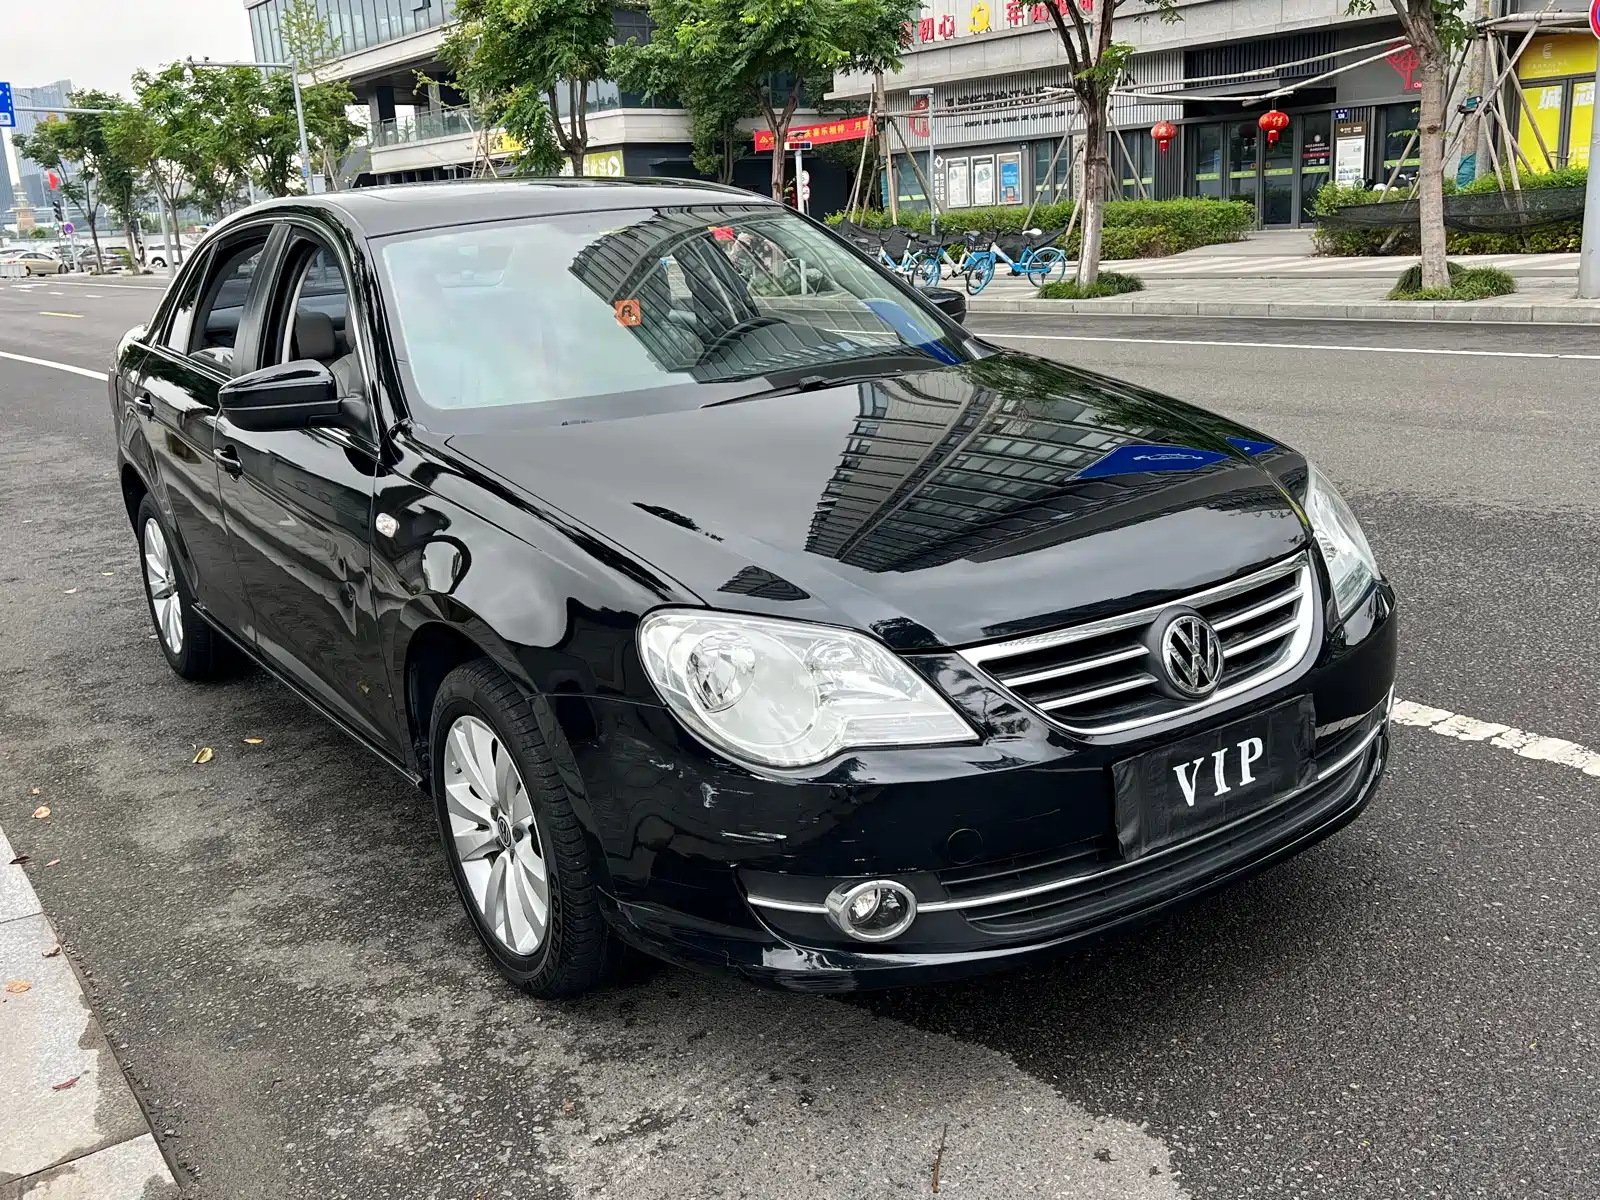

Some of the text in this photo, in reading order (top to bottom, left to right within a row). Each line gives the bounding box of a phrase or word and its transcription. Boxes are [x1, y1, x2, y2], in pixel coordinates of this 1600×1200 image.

[903, 14, 955, 42] 初心
[1172, 737, 1264, 807] VIP
[523, 871, 561, 992] GOODYEAR
